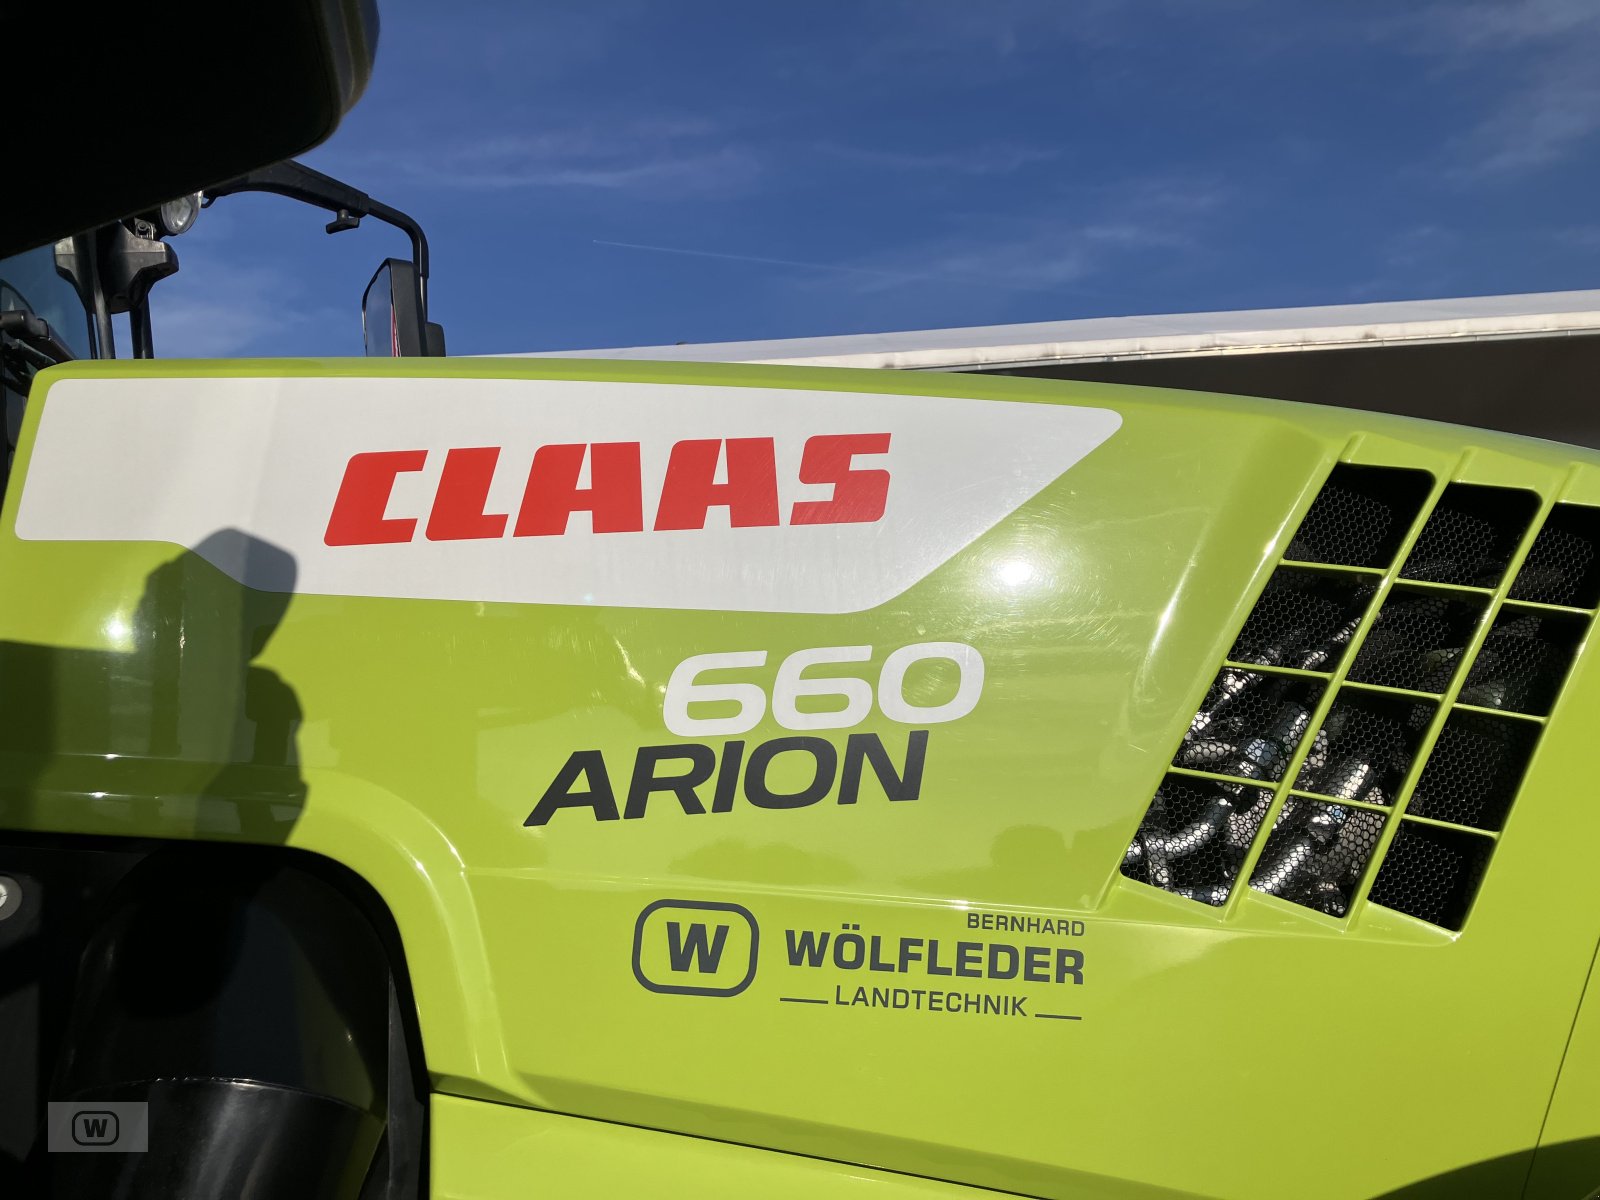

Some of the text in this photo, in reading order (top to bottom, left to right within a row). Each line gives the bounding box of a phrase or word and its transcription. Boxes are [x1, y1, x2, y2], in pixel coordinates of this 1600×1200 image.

[324, 433, 891, 546] CLAAS
[663, 641, 985, 737] 660
[523, 730, 929, 827] ARION
[666, 921, 730, 974] W
[785, 923, 1085, 985] WÖLFLEDER
[967, 913, 1086, 937] BERNHARD
[835, 985, 1028, 1017] LANDTECHNIK
